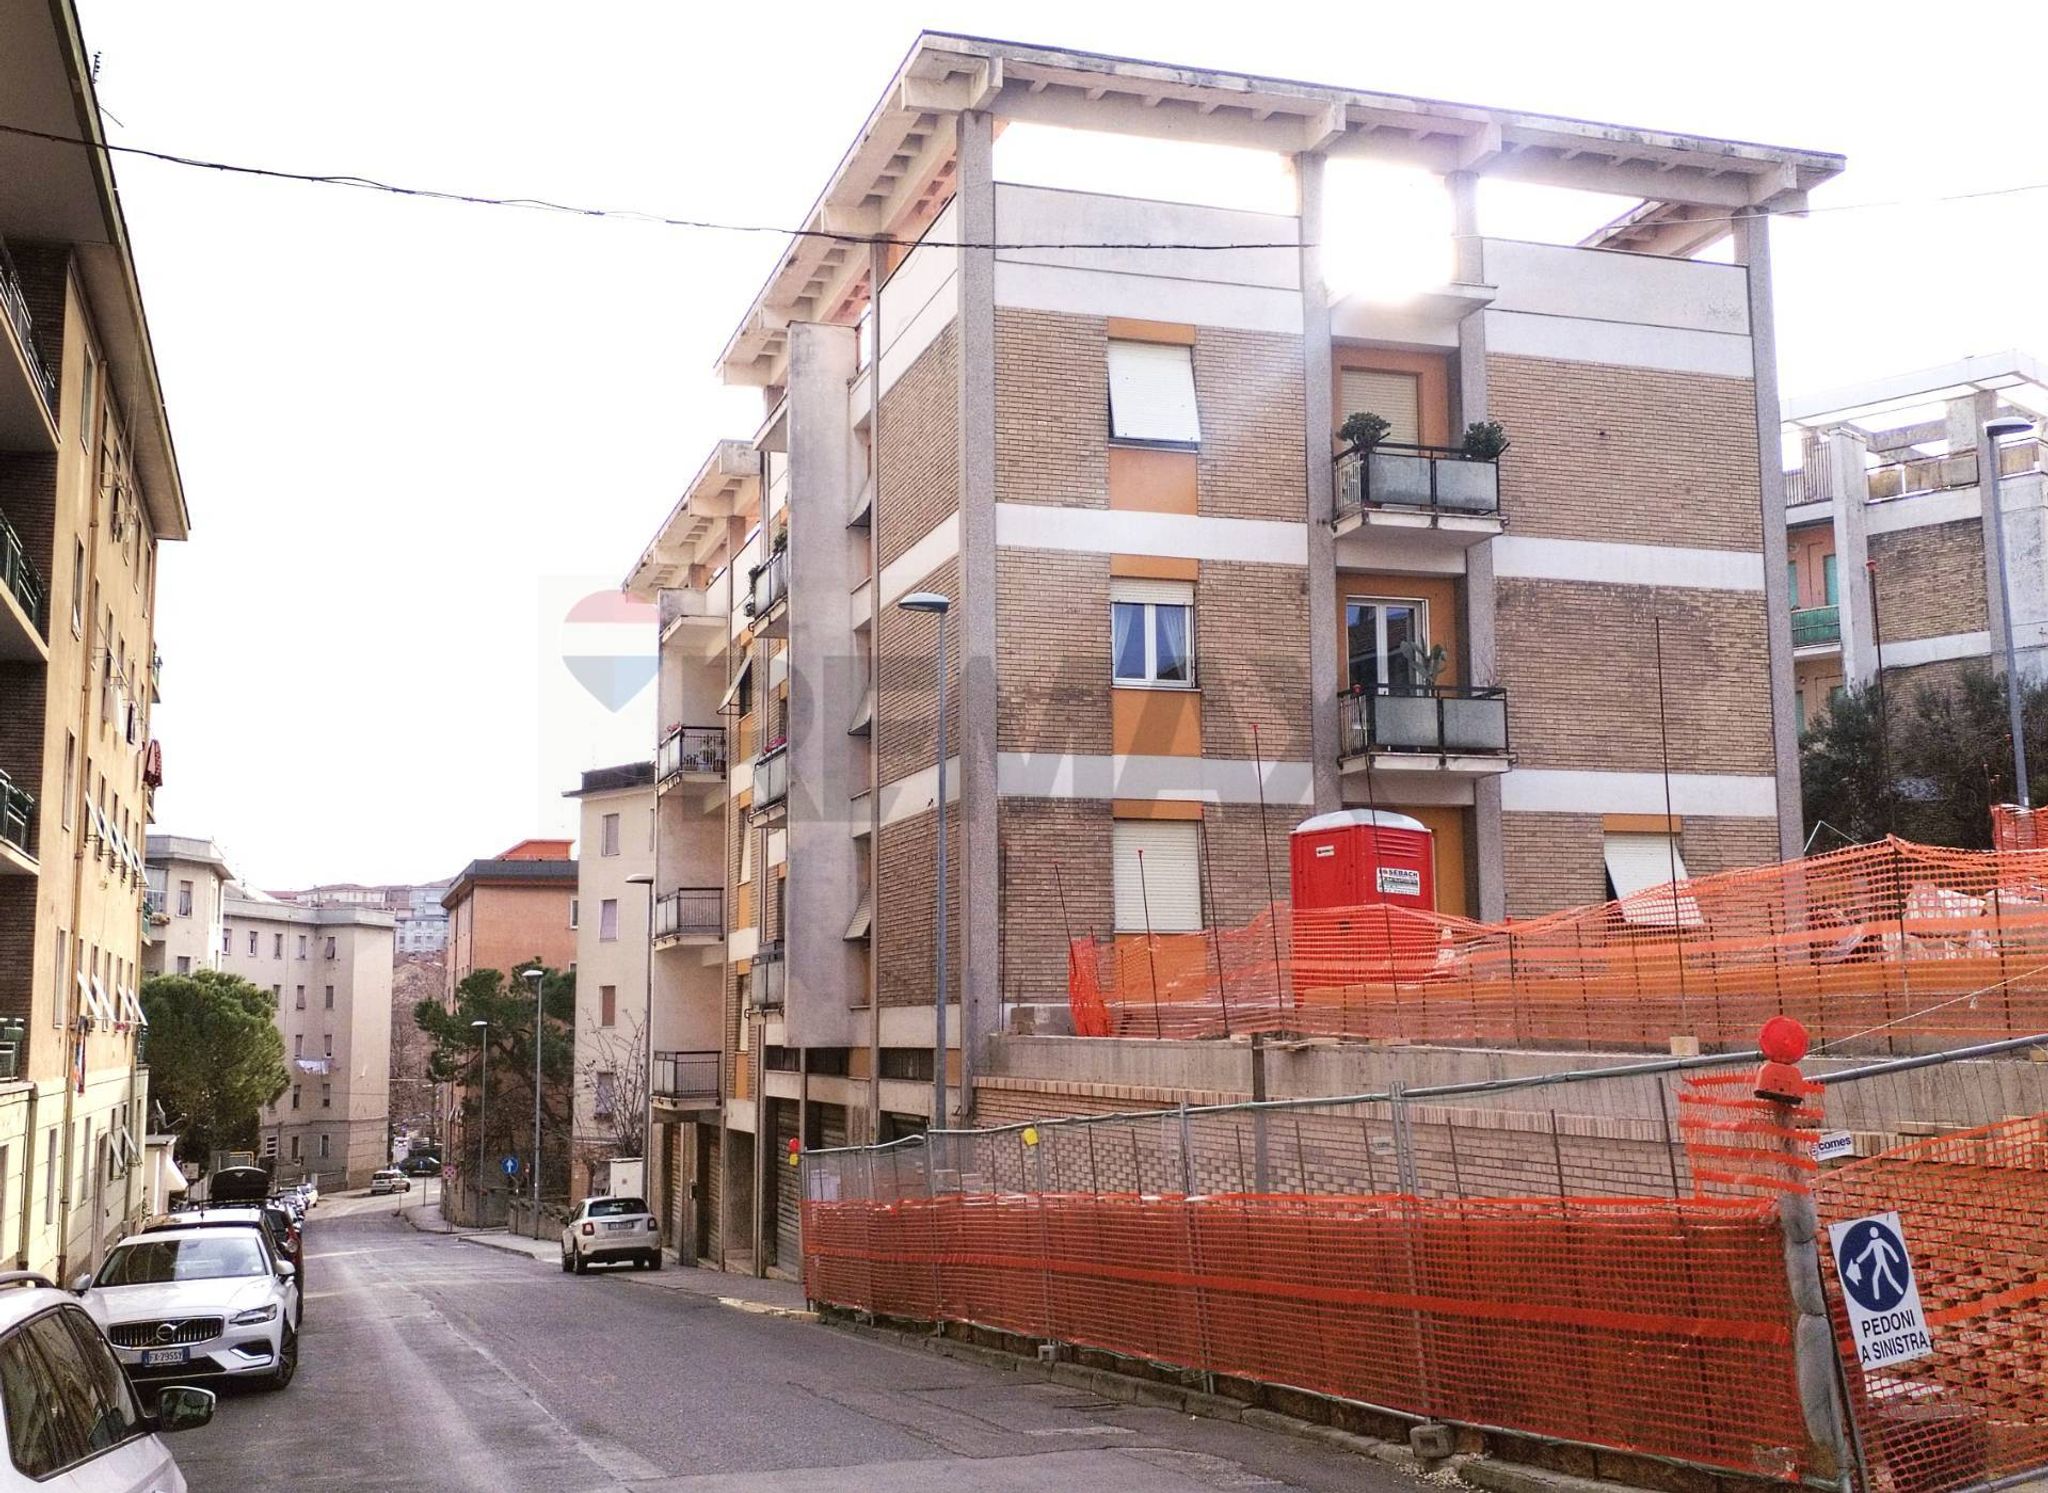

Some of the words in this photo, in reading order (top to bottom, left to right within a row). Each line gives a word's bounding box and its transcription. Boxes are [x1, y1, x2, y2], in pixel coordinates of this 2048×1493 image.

[1861, 1309, 1916, 1338] PEDONI
[1861, 1345, 1872, 1364] A
[1871, 1330, 1929, 1360] SINISTRA
